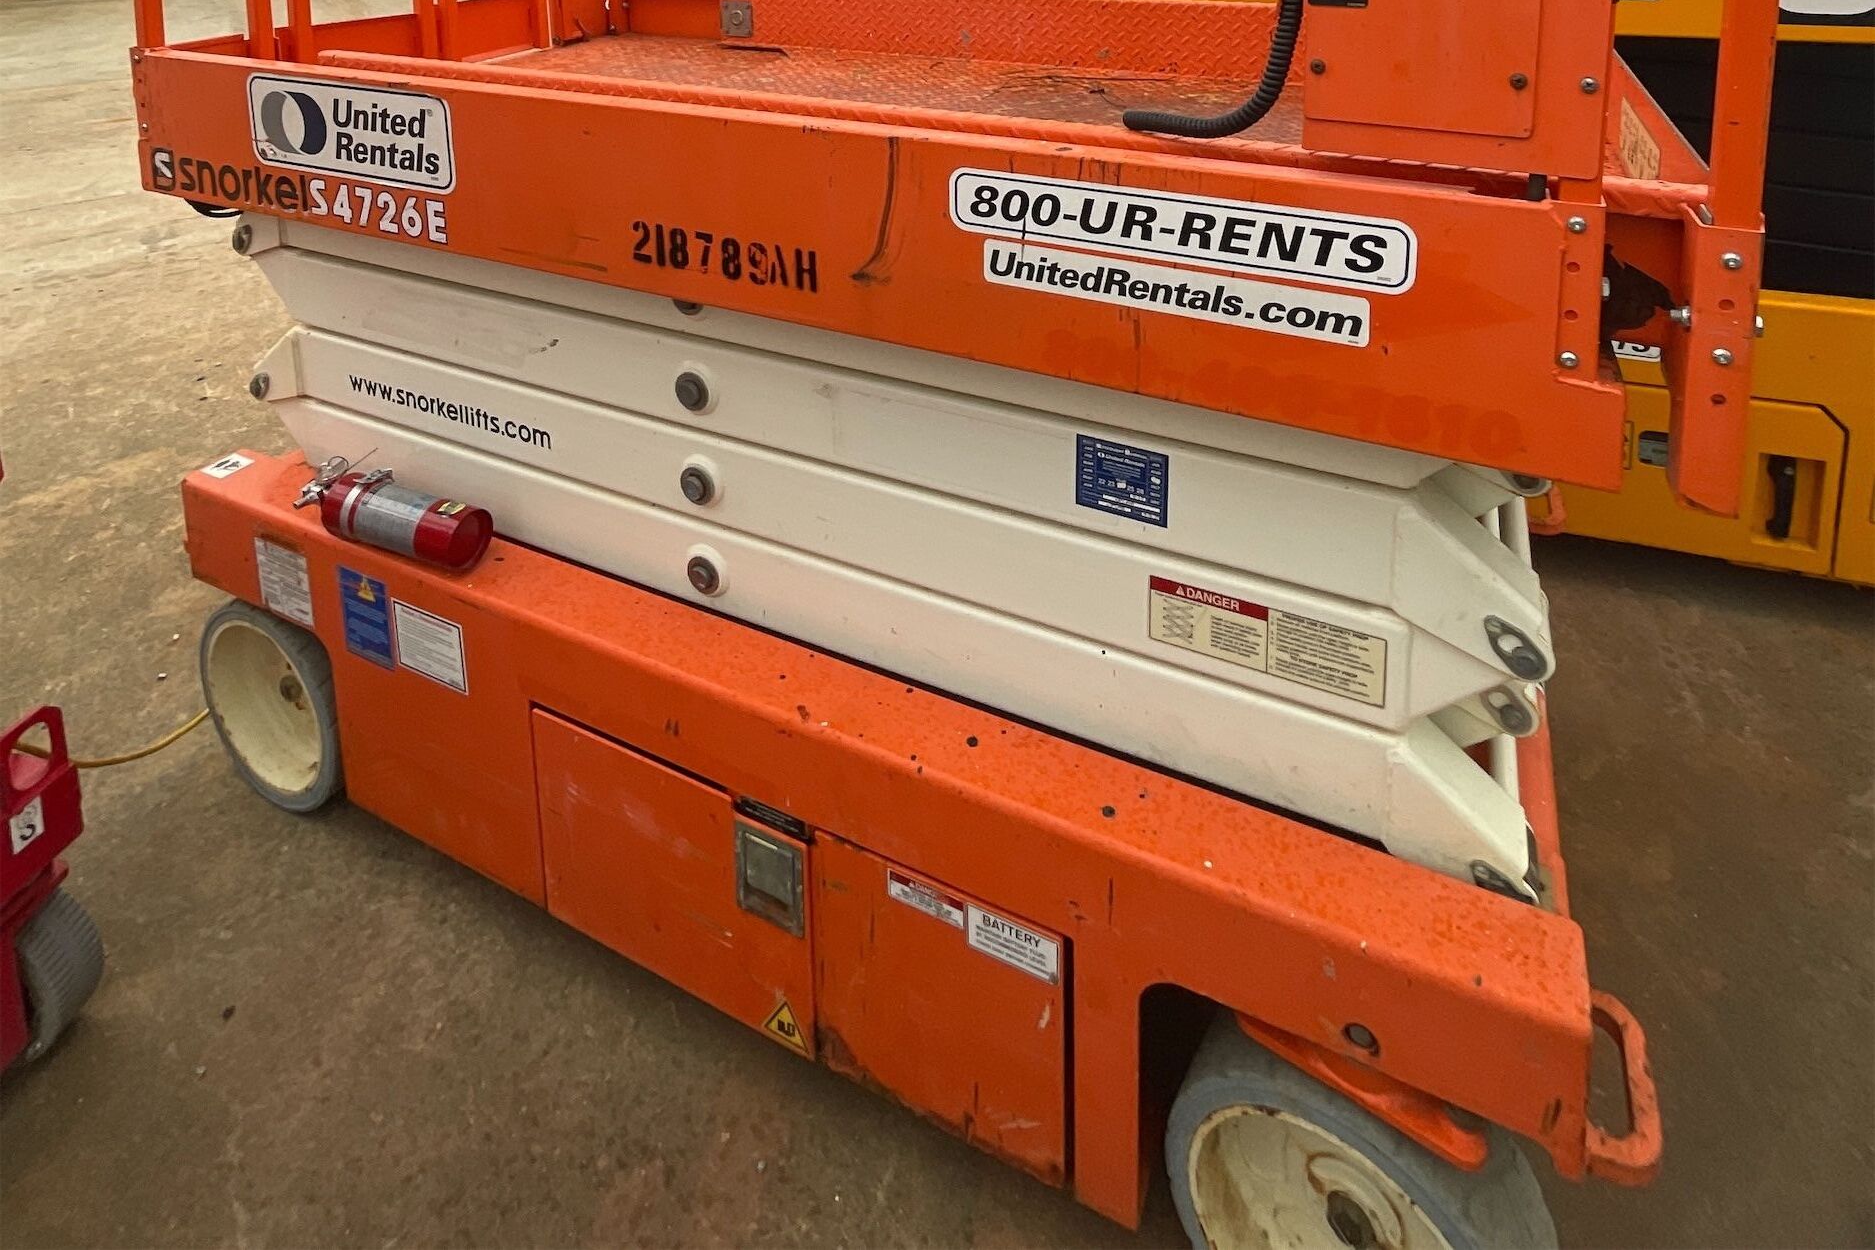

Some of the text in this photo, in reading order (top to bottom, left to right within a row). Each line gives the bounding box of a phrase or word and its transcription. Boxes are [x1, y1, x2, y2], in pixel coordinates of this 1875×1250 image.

[332, 98, 427, 139] United
[335, 131, 440, 175] Rentals
[309, 179, 448, 244] S4726E
[969, 185, 1389, 274] 800-UR-RENTS
[989, 249, 1364, 338] UnitedRentals.com
[349, 374, 552, 450] www.snorkellifts.com
[1186, 587, 1240, 612] DANGER
[982, 913, 1041, 948] BATTERY
